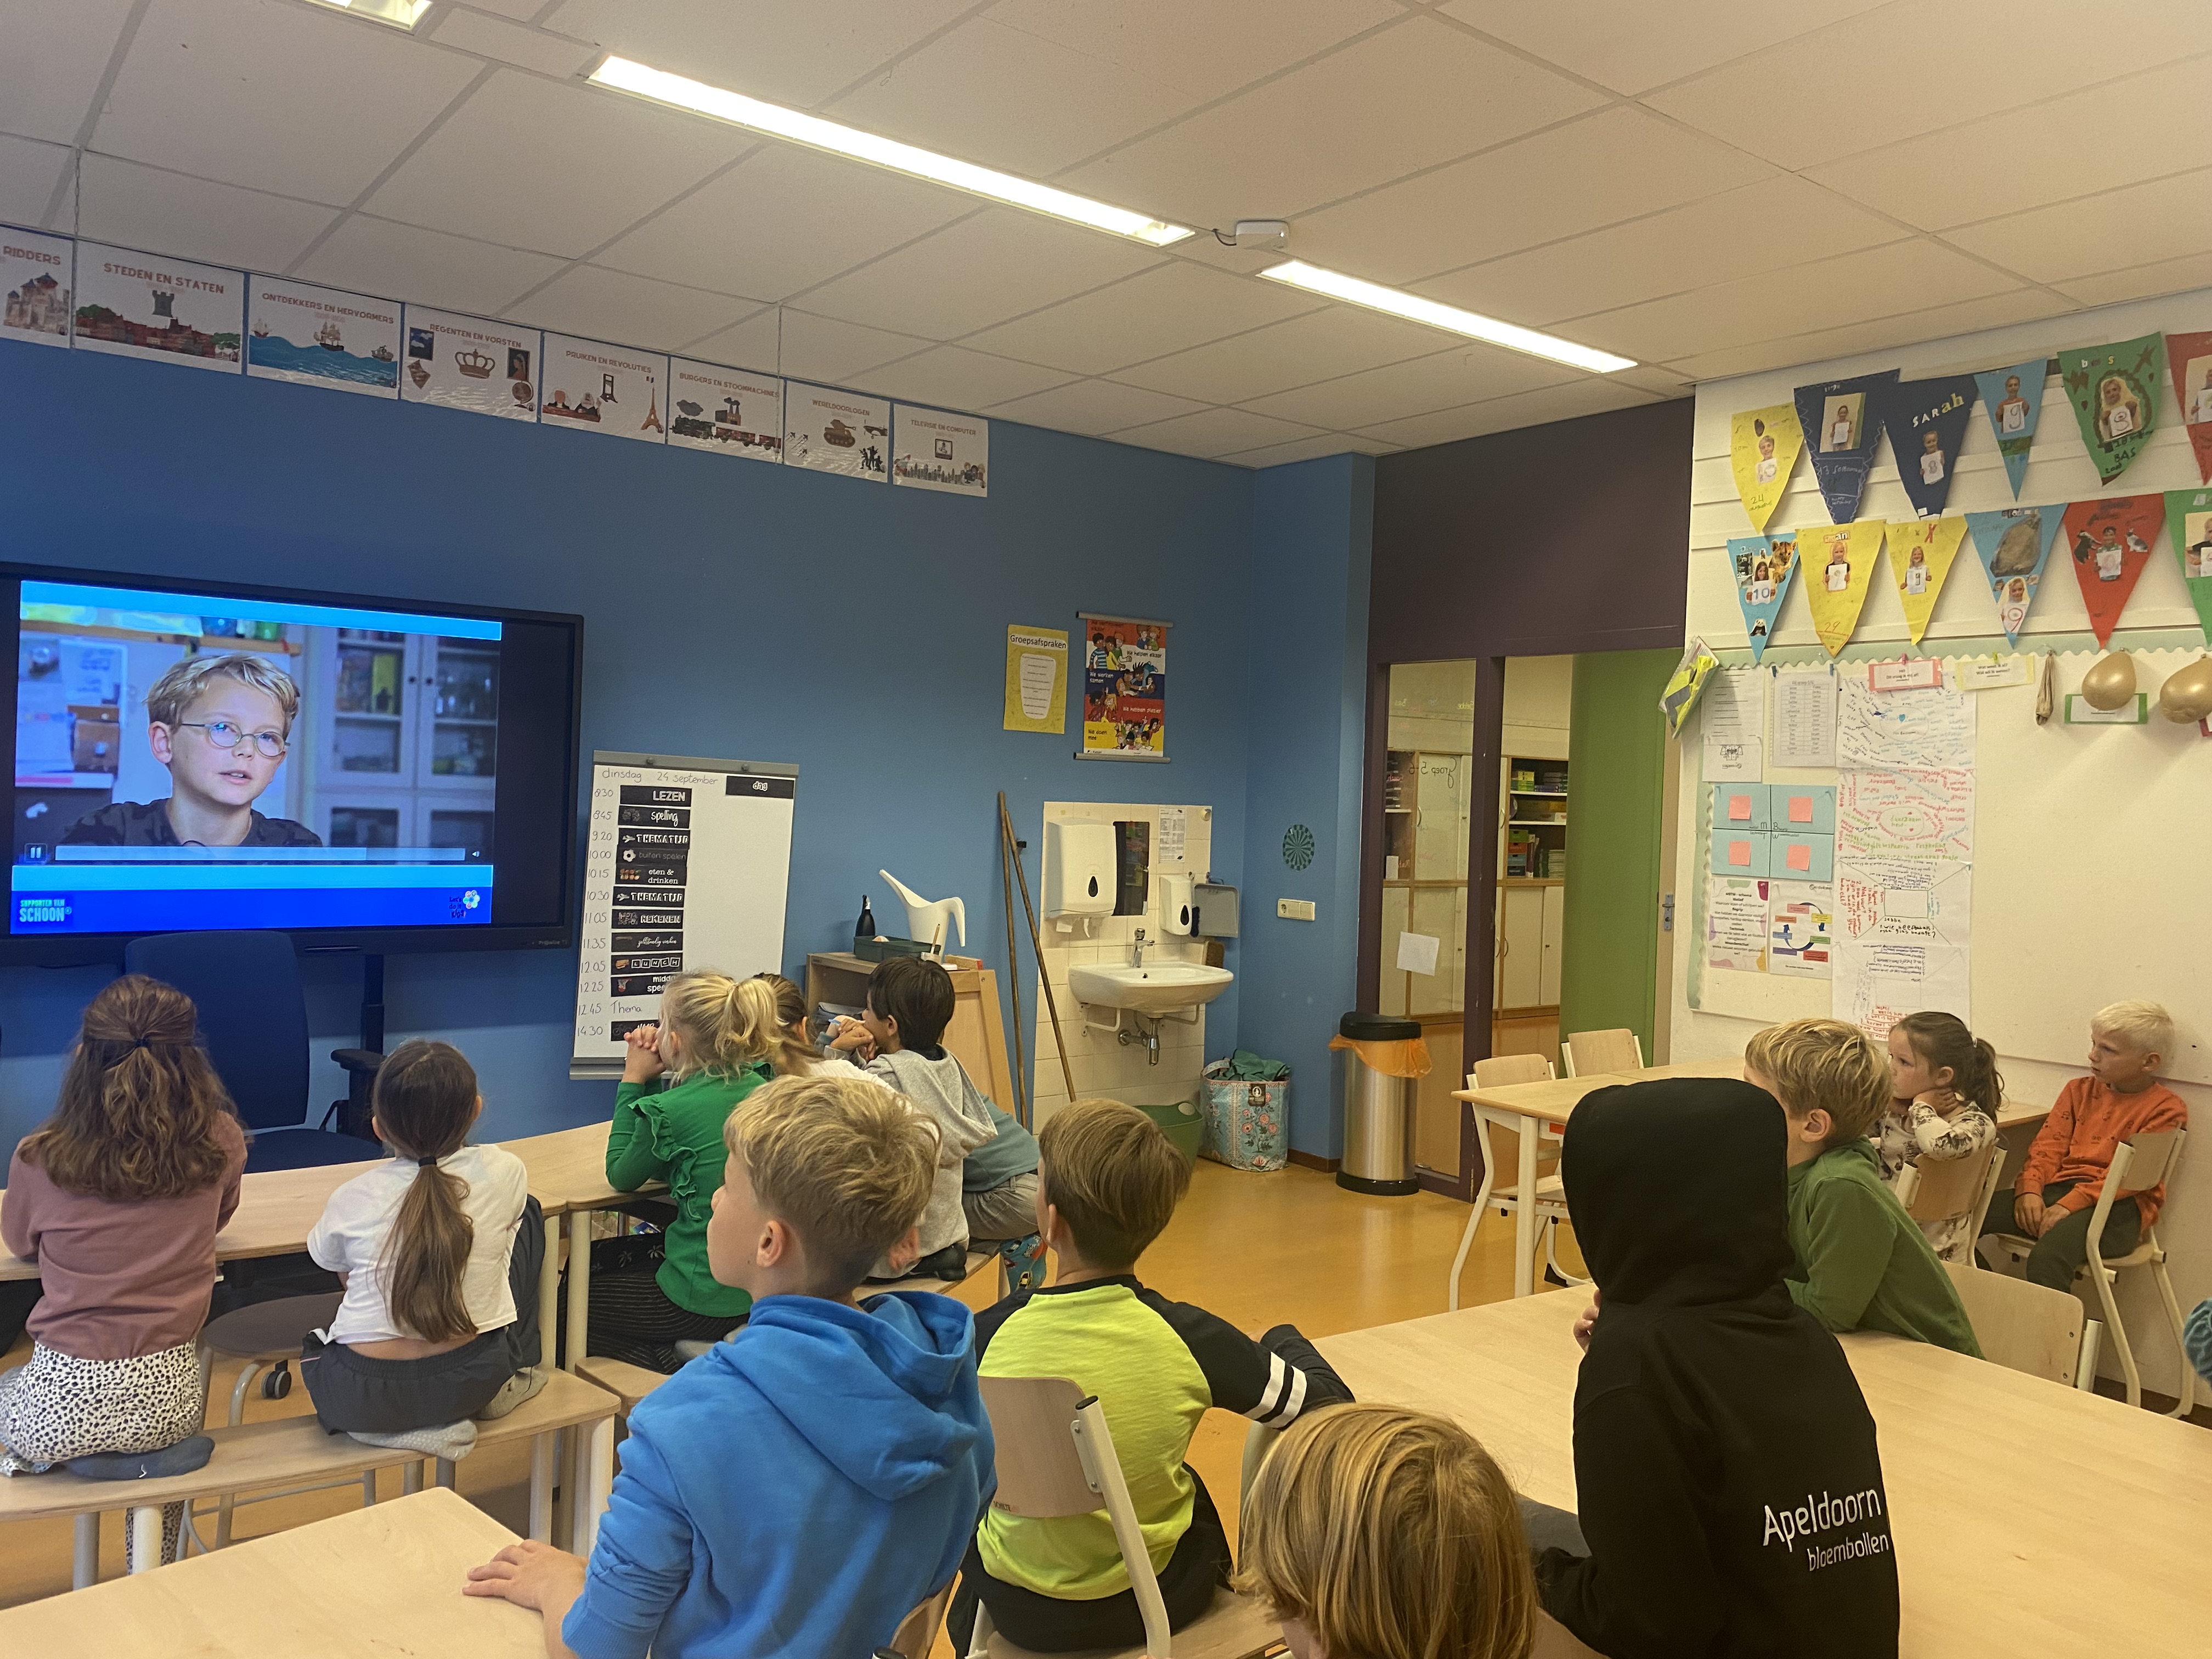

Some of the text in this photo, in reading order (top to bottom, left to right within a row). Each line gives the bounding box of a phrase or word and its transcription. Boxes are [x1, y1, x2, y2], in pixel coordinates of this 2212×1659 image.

[3, 246, 61, 266] RIDDERS
[103, 263, 224, 295] STEDEN EN STATEN
[262, 292, 323, 311] ONTDEKKERS
[324, 304, 335, 313] EN
[337, 307, 394, 324] HERVORMERS
[430, 324, 472, 339] REGENTEN
[484, 335, 522, 348] VORSTEN
[566, 351, 597, 362] PRUIKEN
[608, 359, 652, 374] REVOLUTIES
[679, 373, 712, 385] BURGERS
[724, 381, 780, 398] STOOMMACHINES
[812, 399, 870, 416] WERELDOORLOGEN
[911, 419, 937, 430] TELEVISIE
[946, 425, 977, 436] COMPUTER
[1752, 588, 1770, 600] 10
[1010, 635, 1066, 649] Groepsafspraken
[602, 768, 719, 785] dinsdag 24 september
[752, 781, 769, 792] dag
[652, 790, 686, 802] LEZEN
[651, 809, 679, 827] spelling
[636, 834, 689, 844] THEMATIJD
[639, 851, 686, 862] buiten spelen
[630, 892, 684, 902] THEMATIJD
[19, 907, 65, 922] SCHOON
[640, 915, 681, 924] REKENEN
[631, 957, 681, 969] LUNCH
[610, 1000, 642, 1014] Thema
[1763, 1489, 1882, 1553] Apeldoorn
[1807, 1532, 1889, 1572] bloembollen
